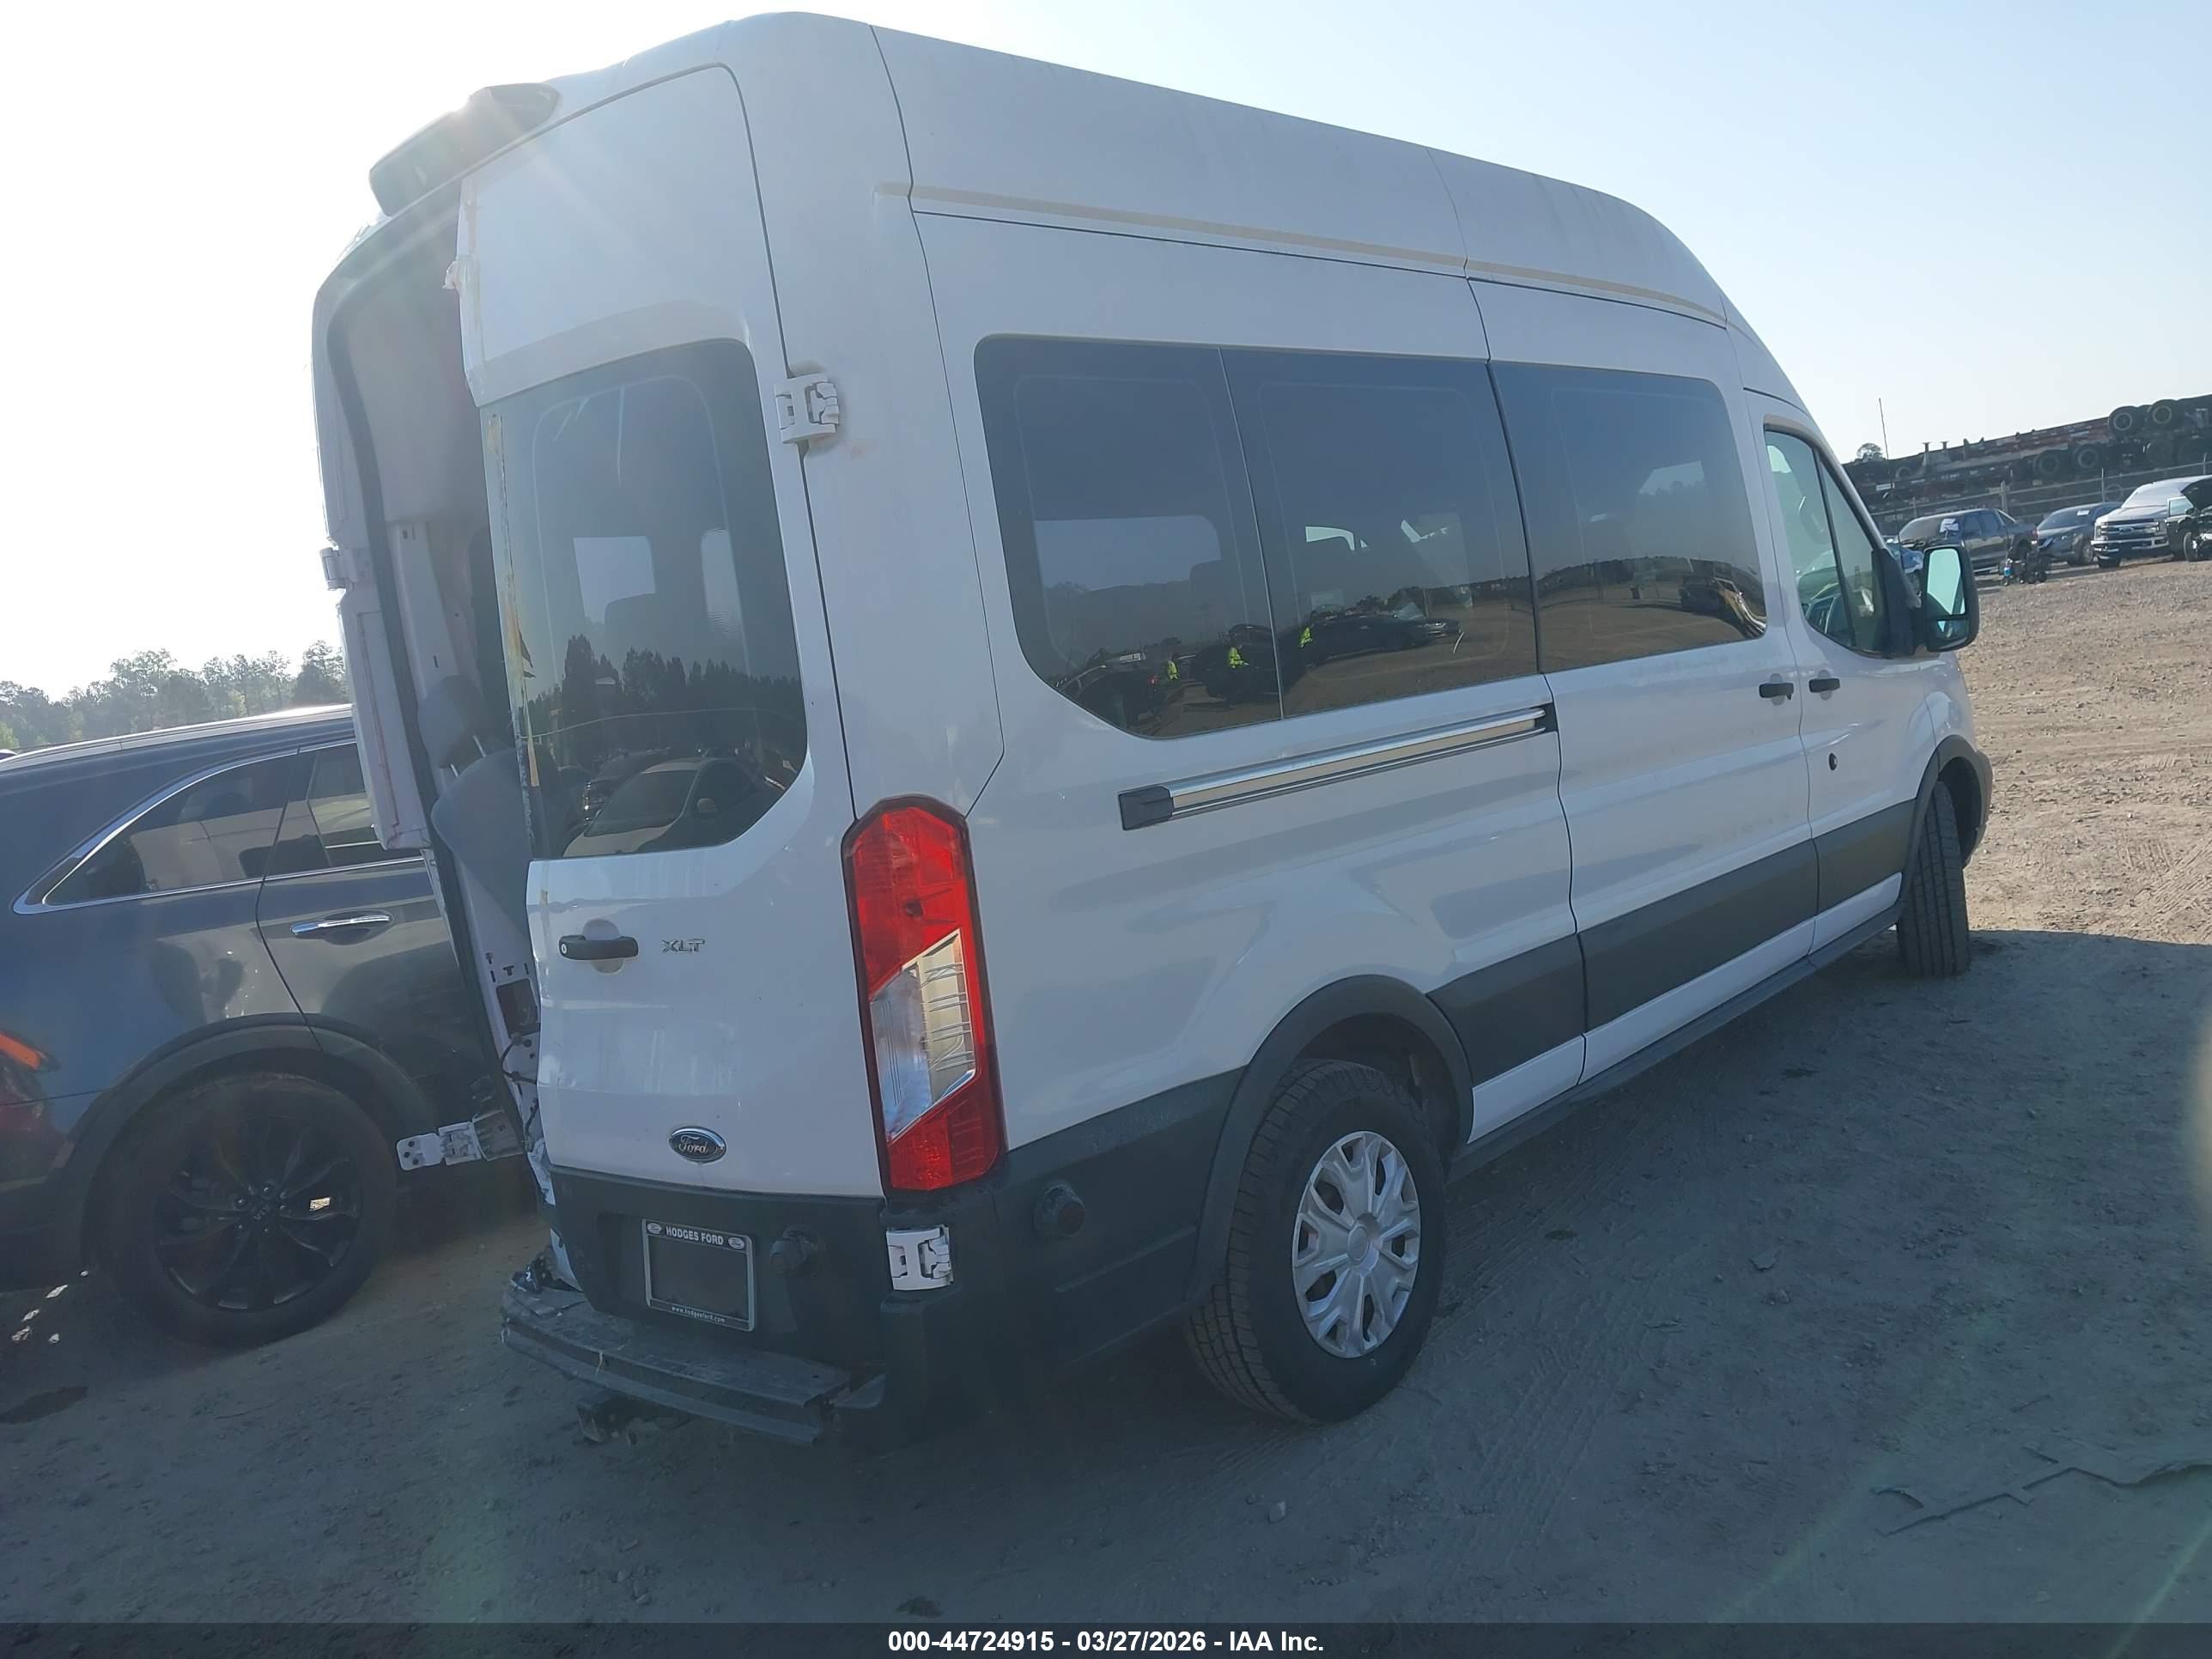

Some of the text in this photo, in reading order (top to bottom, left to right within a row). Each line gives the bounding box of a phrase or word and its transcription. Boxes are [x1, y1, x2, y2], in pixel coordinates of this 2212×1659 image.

[661, 938, 706, 952] XLT
[678, 1134, 708, 1154] Ford
[665, 1226, 699, 1242] HODGES
[701, 1232, 724, 1245] FORD
